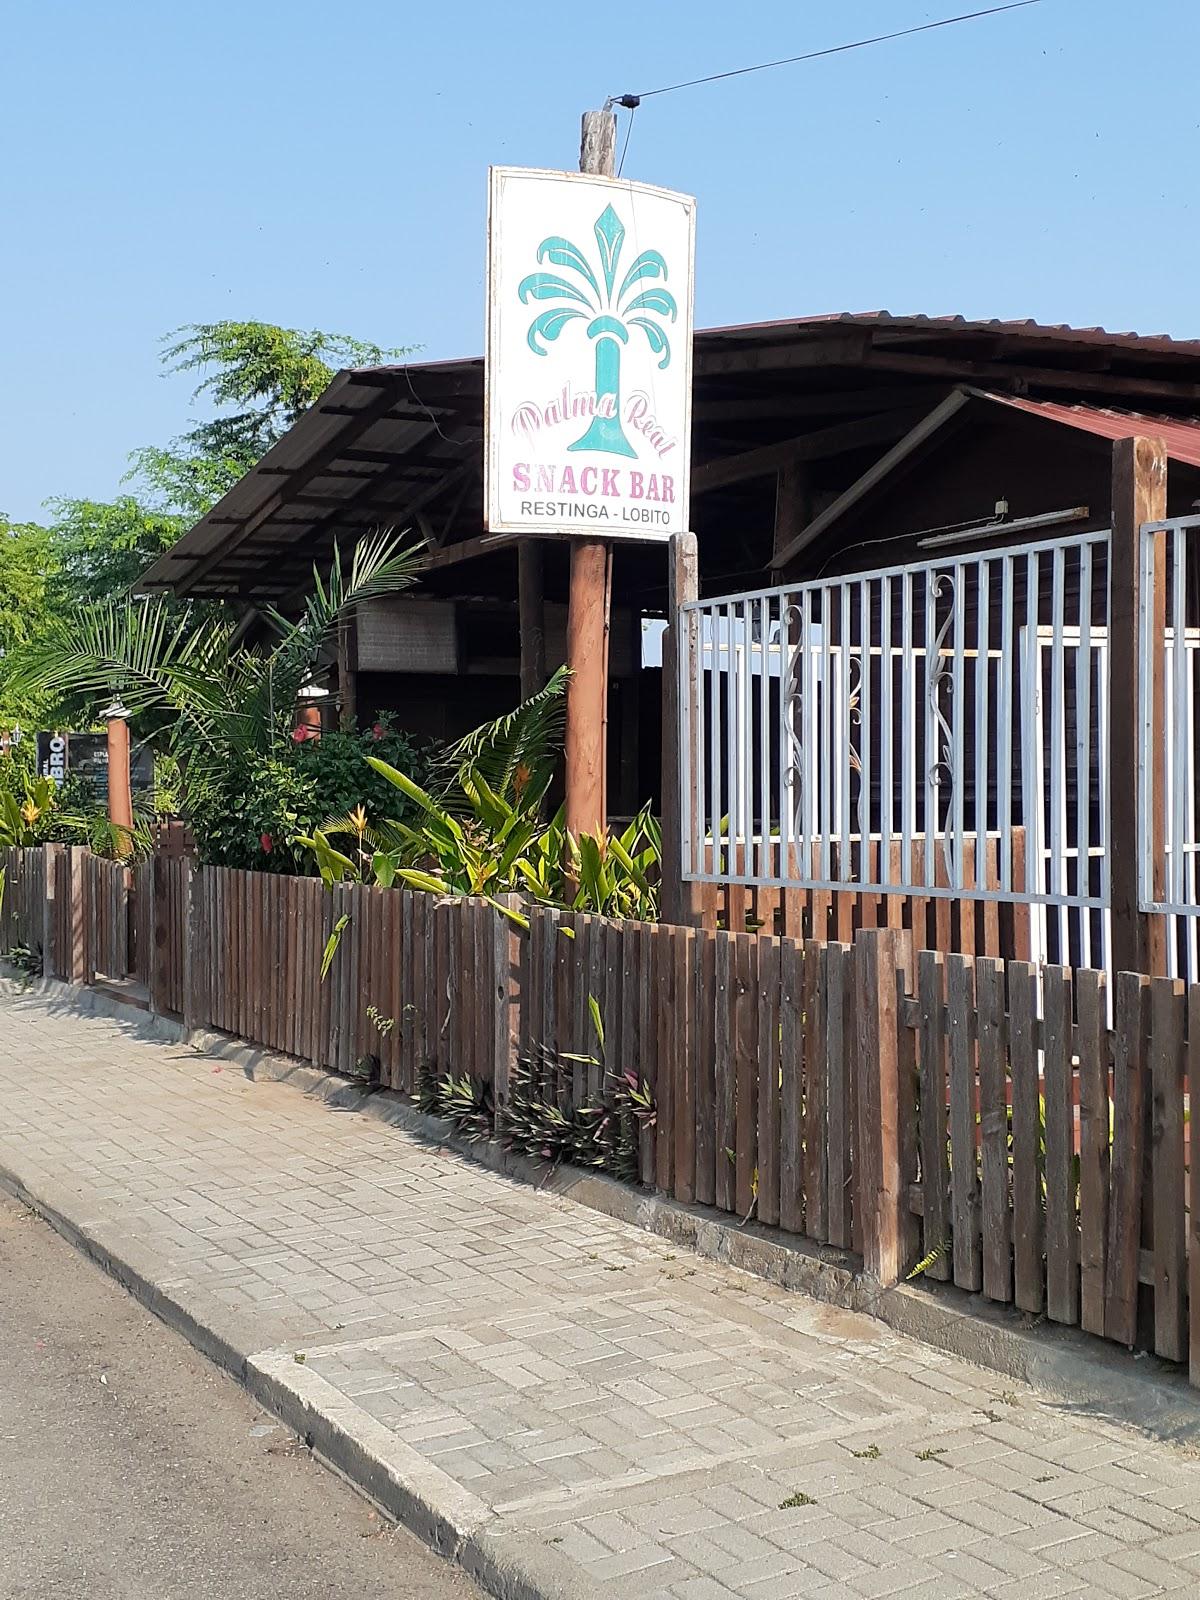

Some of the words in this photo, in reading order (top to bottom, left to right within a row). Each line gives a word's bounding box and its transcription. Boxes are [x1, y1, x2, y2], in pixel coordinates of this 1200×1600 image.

[511, 380, 617, 441] Palma
[624, 390, 678, 460] Real
[513, 462, 621, 497] SNACK
[629, 470, 676, 503] BAR
[521, 501, 609, 519] RESTINGA
[622, 507, 671, 525] LOBITO
